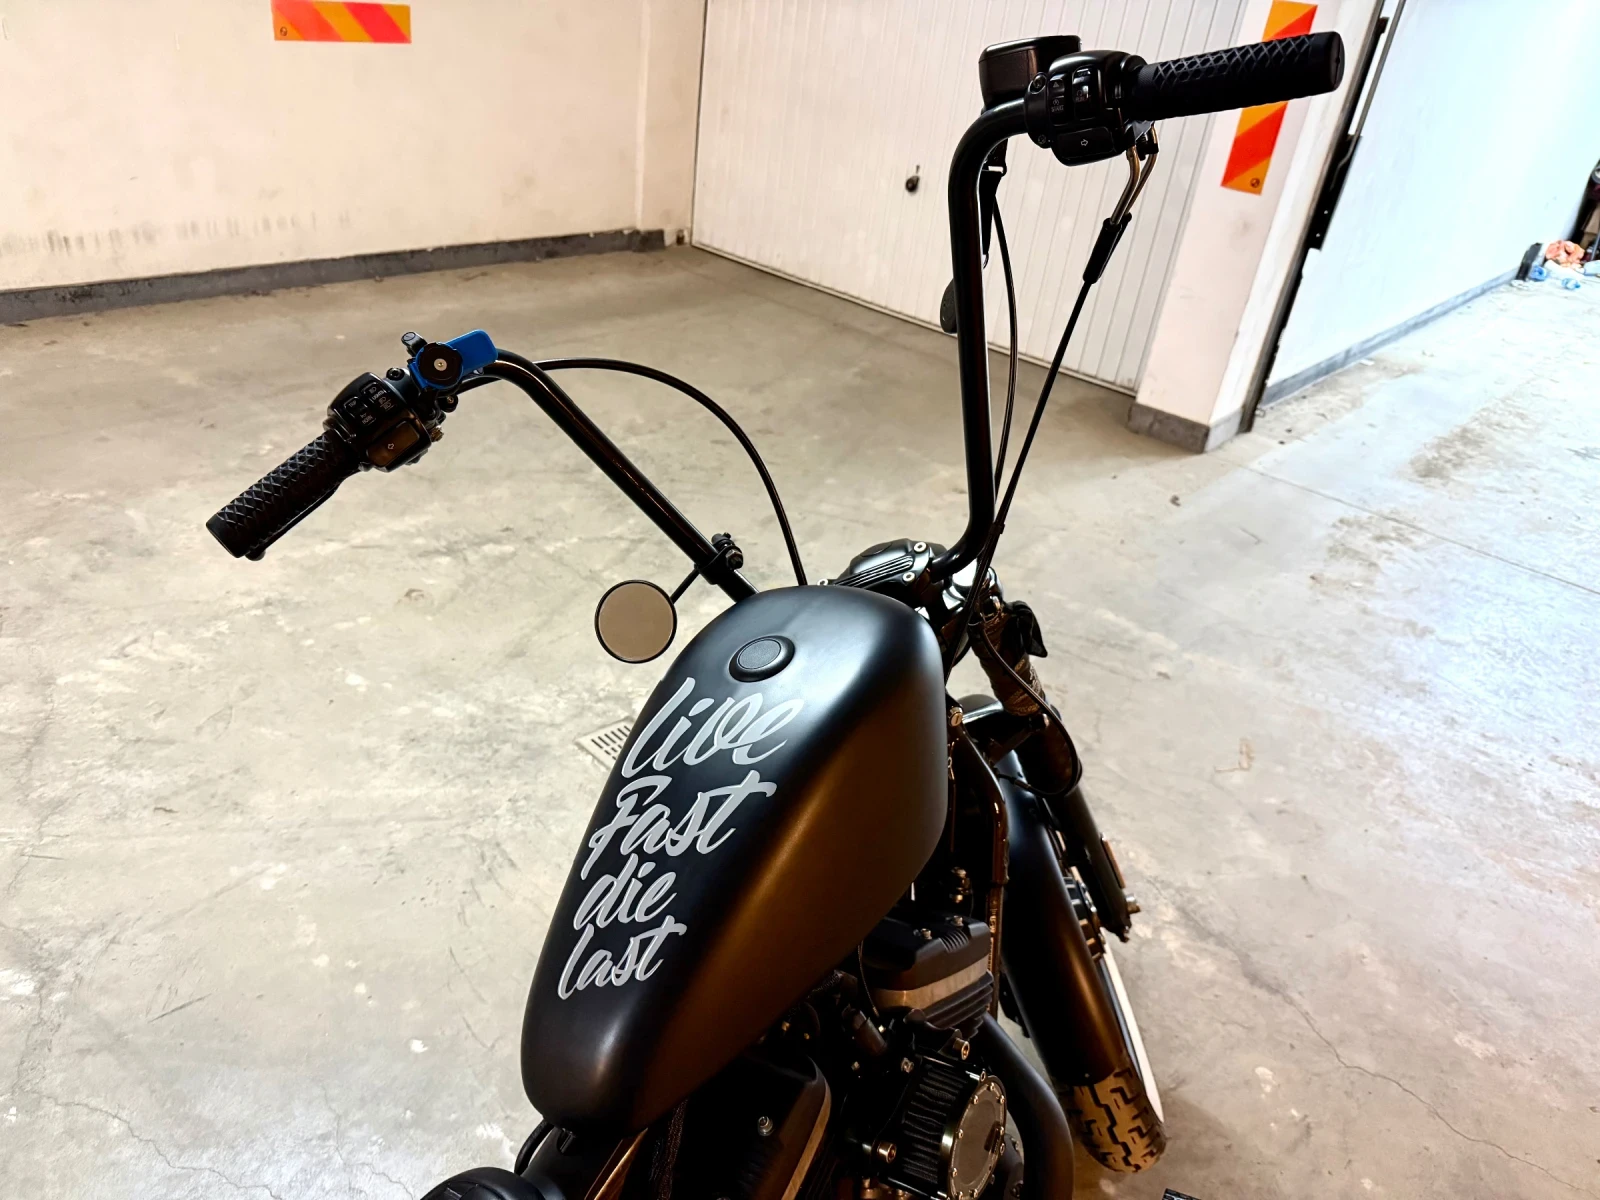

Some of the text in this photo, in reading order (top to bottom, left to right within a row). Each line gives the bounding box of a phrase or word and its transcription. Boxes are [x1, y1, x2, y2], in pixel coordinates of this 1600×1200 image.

[621, 677, 804, 778] live
[573, 853, 677, 930] die
[558, 915, 687, 1000] last
